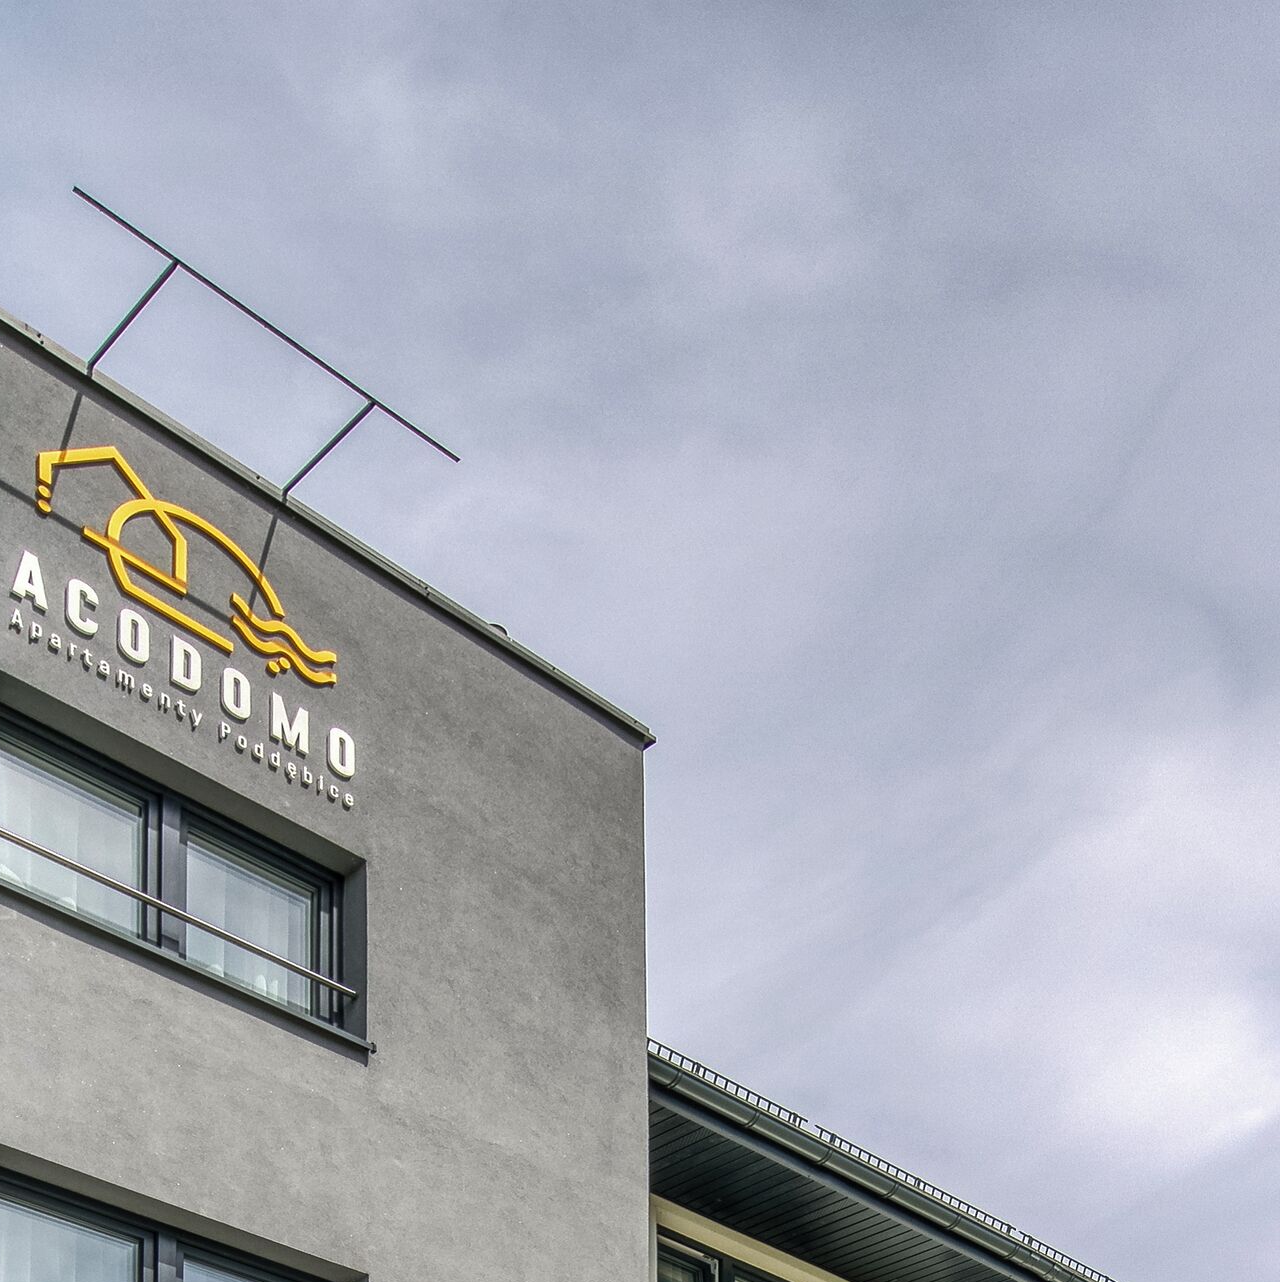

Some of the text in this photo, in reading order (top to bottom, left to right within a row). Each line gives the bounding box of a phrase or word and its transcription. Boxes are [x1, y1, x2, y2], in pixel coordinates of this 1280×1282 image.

[9, 608, 355, 808] Apartamenty Poddębice
[10, 550, 355, 779] ACODOMO
